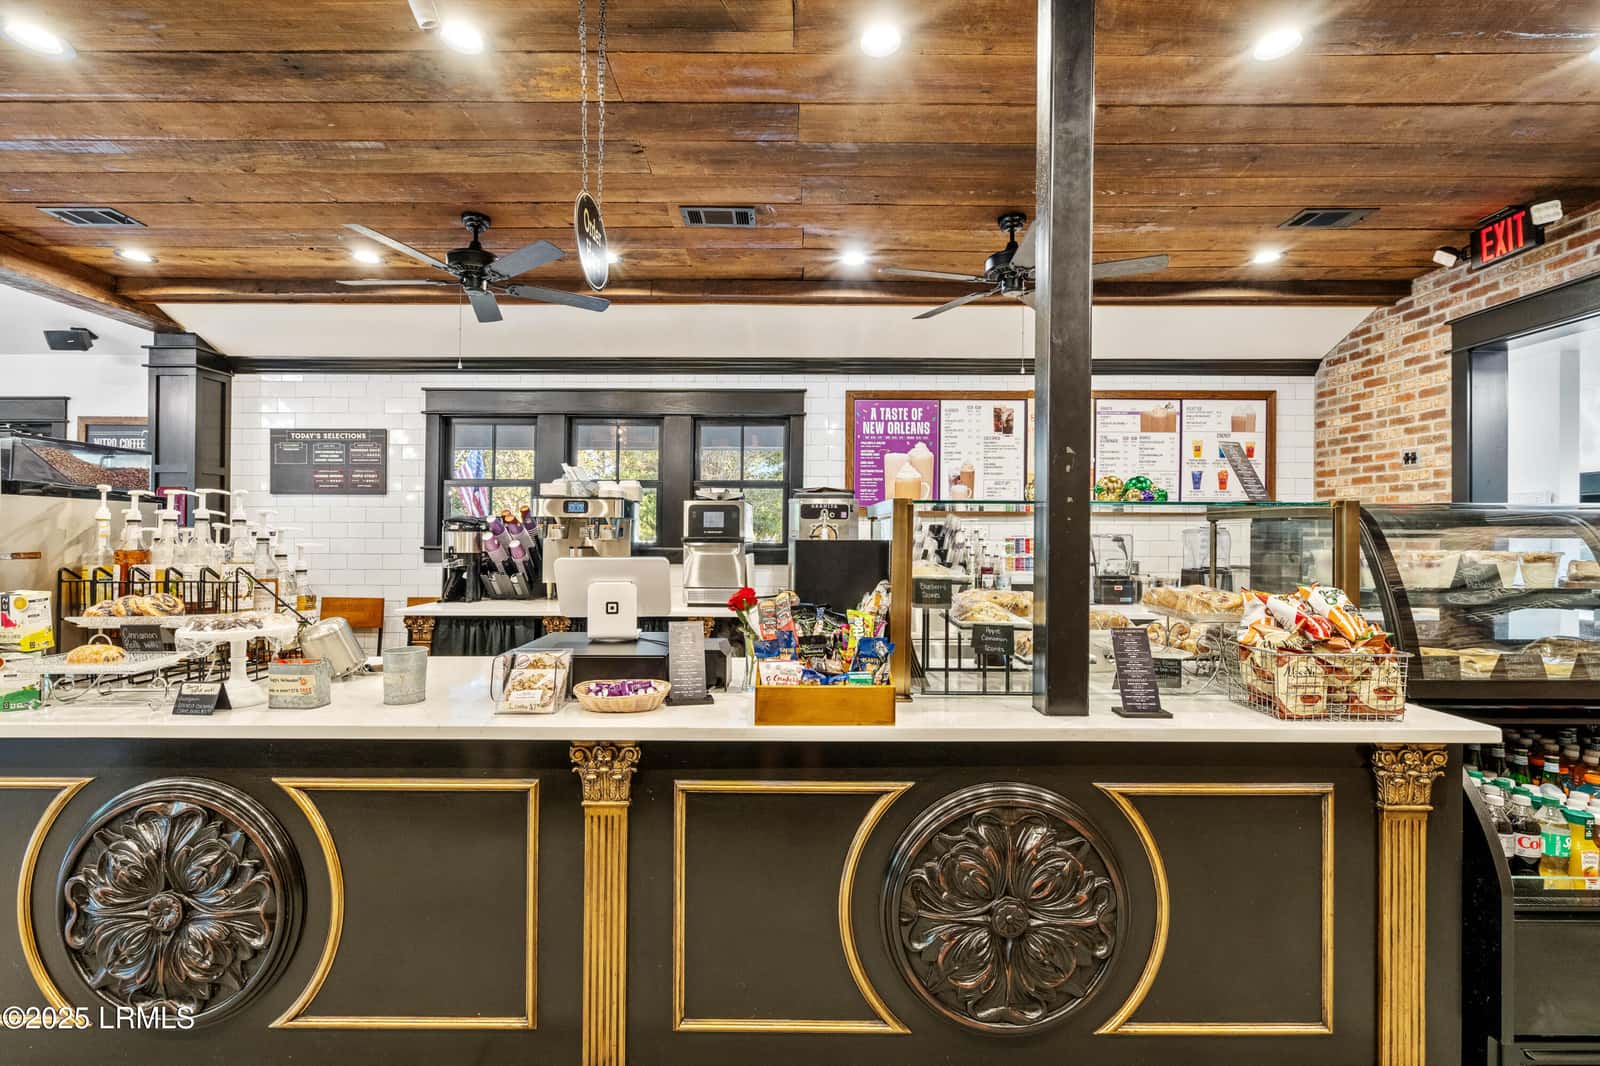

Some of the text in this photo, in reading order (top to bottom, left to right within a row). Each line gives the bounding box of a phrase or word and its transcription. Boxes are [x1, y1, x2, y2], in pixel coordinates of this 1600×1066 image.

[1480, 210, 1526, 264] EXIT
[870, 407, 923, 420] A TASTE OF
[862, 421, 931, 434] NEW ORLEANS
[291, 432, 367, 440] TODAY'S SELECTIONS
[93, 437, 146, 449] NITRO COFFEE
